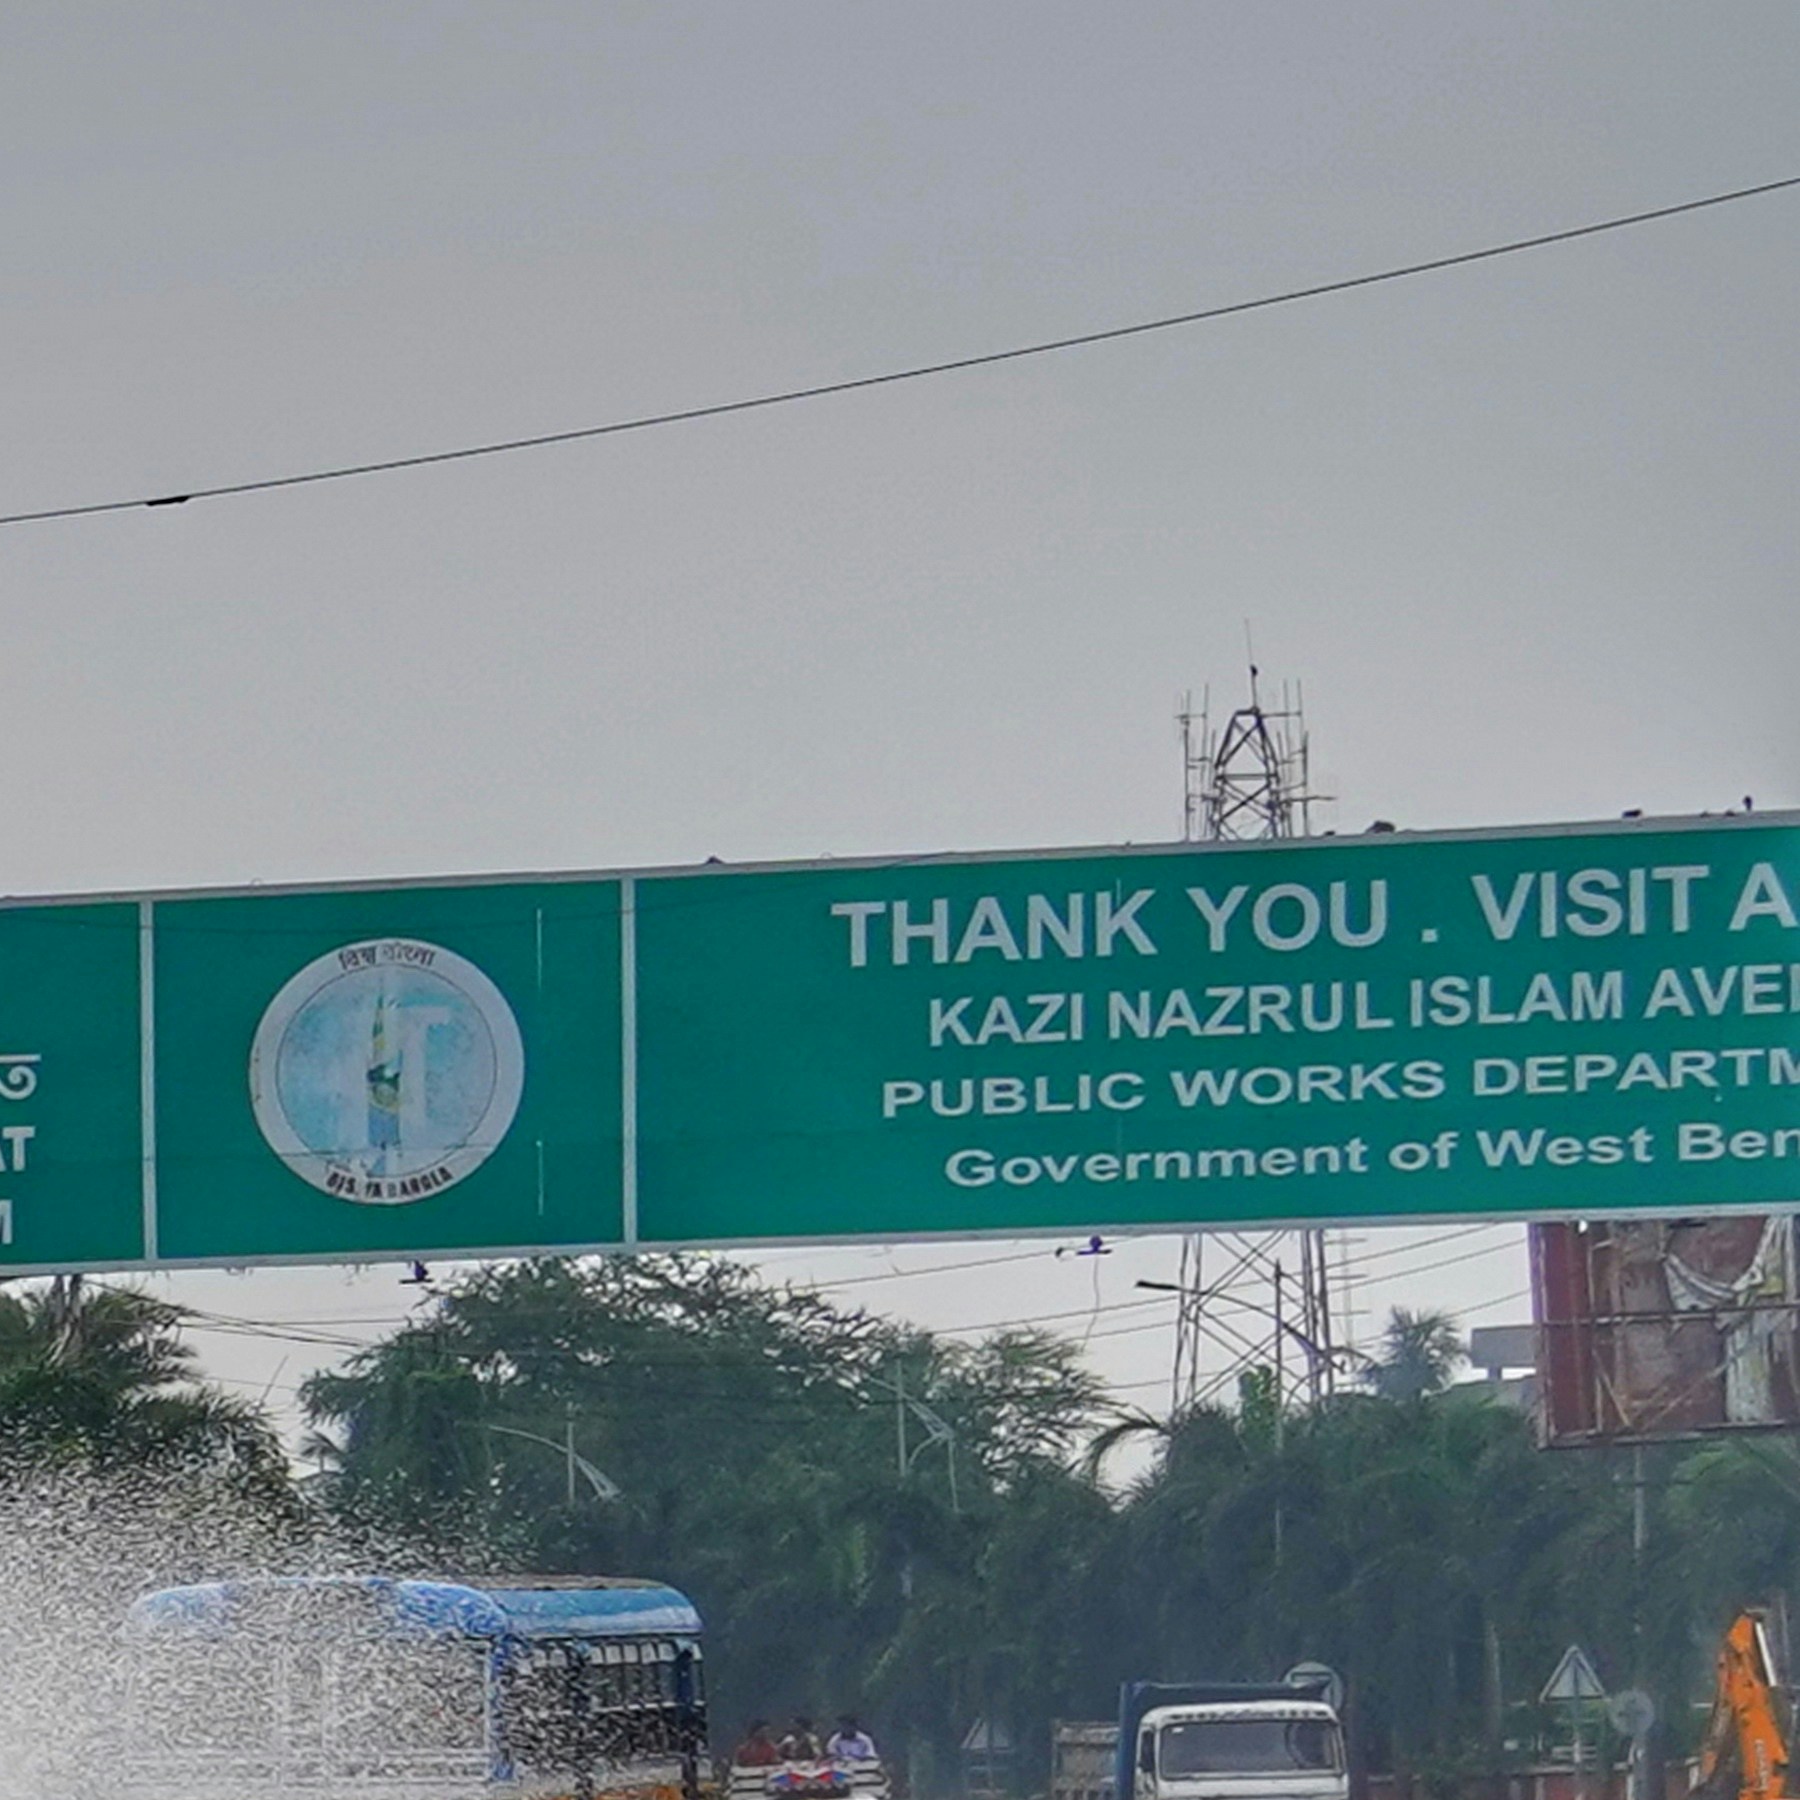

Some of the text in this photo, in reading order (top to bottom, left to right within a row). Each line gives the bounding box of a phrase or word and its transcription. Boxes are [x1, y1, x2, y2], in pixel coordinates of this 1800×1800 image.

[830, 888, 1158, 967] THANK
[1186, 879, 1387, 952] YOU
[1471, 865, 1710, 941] VISIT
[930, 963, 1800, 1047] KAZI NAZRUL ISLAM AVE
[883, 1072, 1146, 1119] PUBLIC
[1170, 1061, 1446, 1107] WORKS
[944, 1137, 1368, 1188] Government
[1388, 1131, 1459, 1172] of
[1476, 1126, 1655, 1168] West
